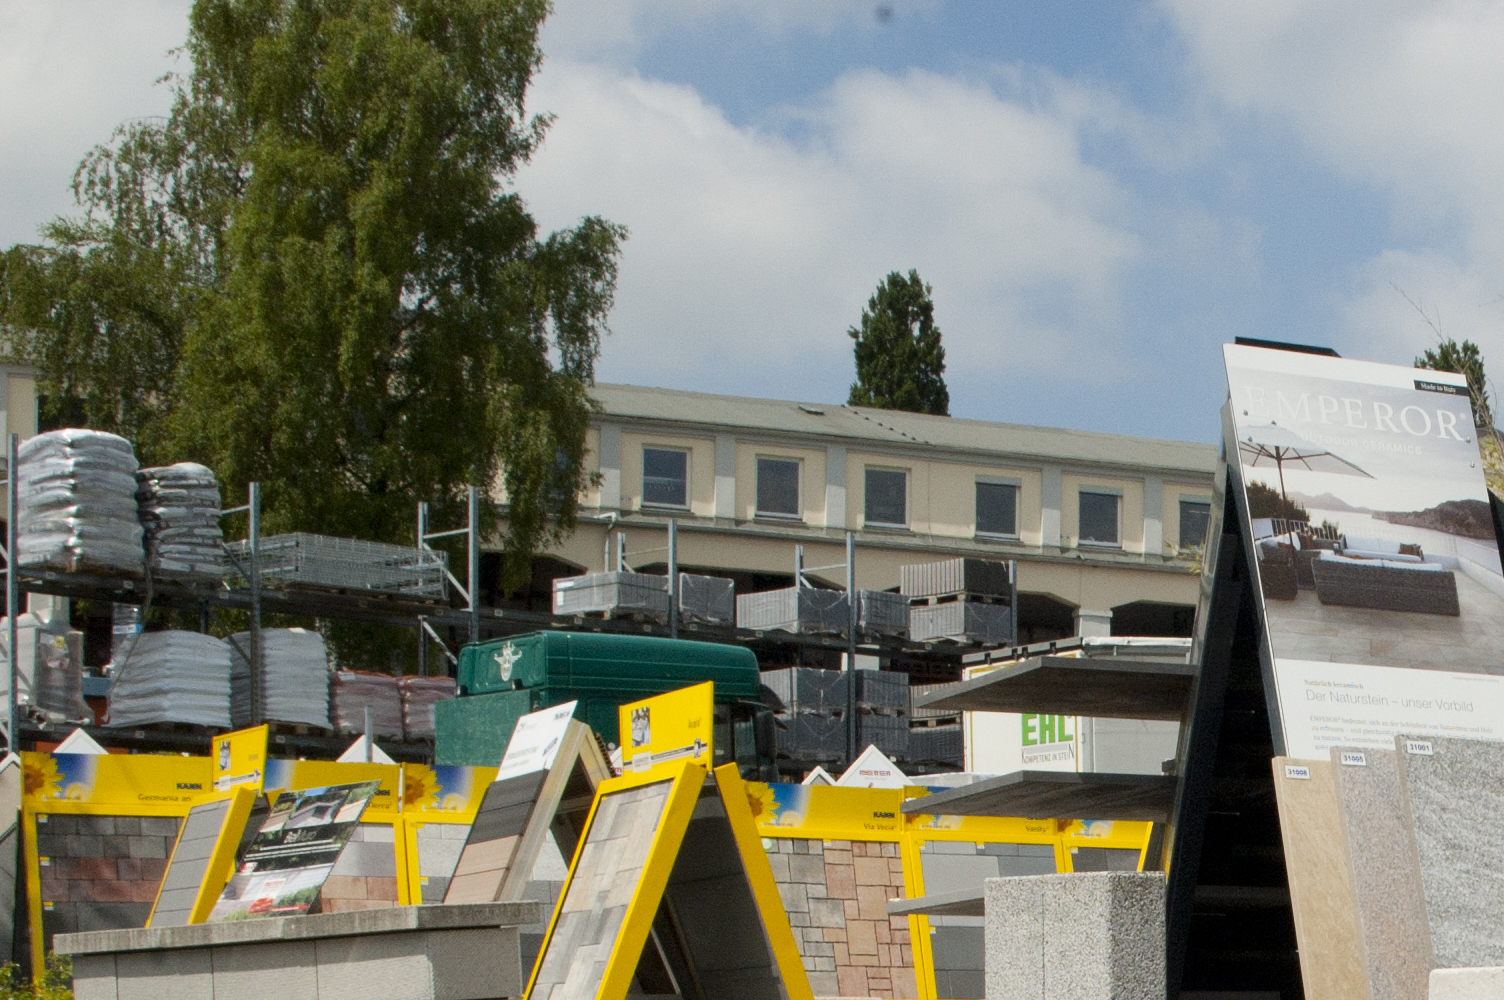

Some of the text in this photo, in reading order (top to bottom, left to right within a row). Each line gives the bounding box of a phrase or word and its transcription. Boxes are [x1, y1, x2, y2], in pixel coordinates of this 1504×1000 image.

[1301, 434, 1422, 455] OUTDOOR CERAMICS
[1306, 689, 1326, 702] Der
[1330, 690, 1388, 706] Naturstein
[1401, 699, 1433, 709] unser
[1435, 699, 1474, 712] Vorbild
[1022, 713, 1074, 746] EHL
[1052, 753, 1057, 761] IN
